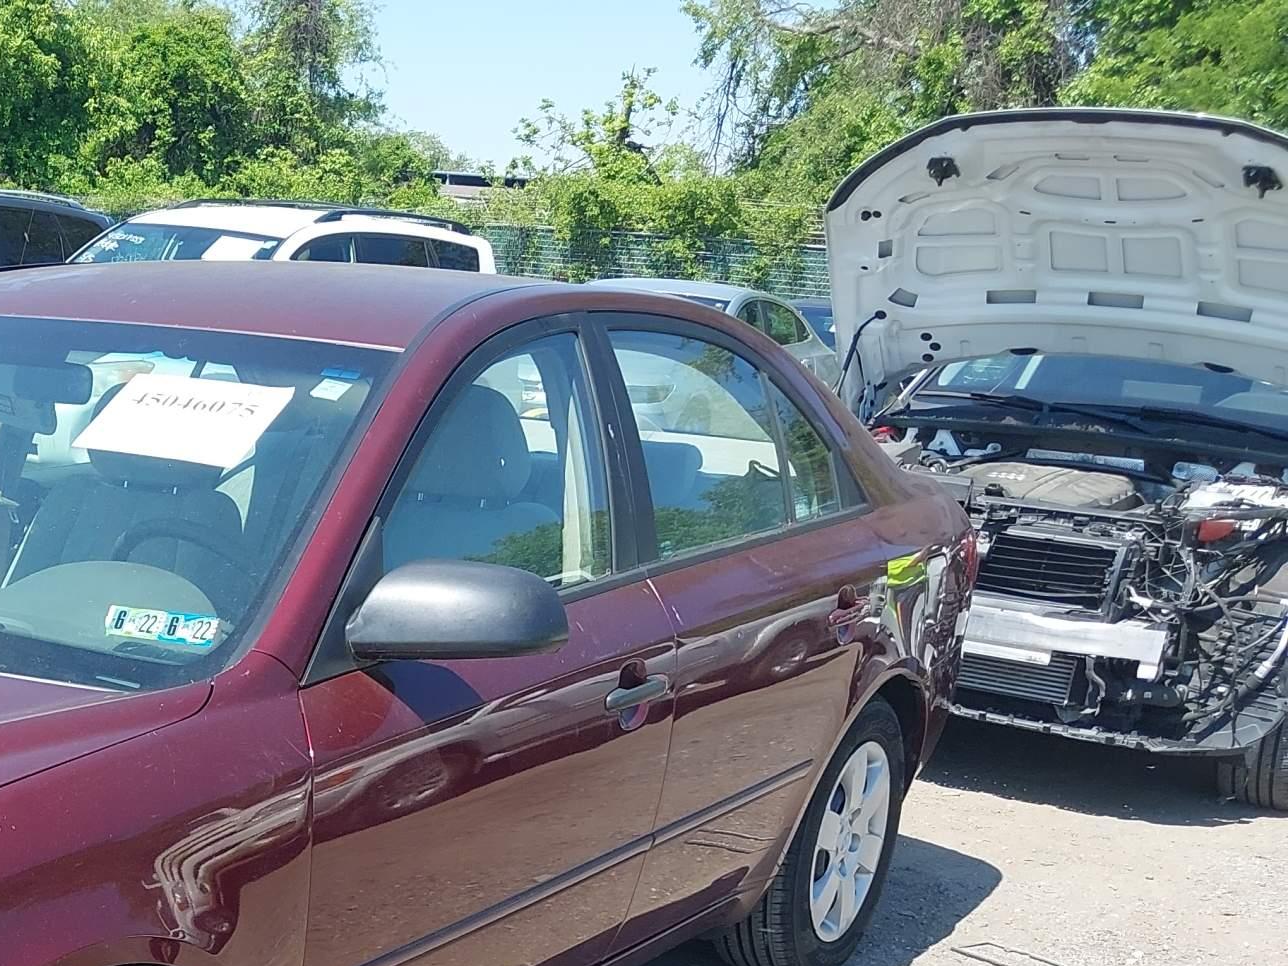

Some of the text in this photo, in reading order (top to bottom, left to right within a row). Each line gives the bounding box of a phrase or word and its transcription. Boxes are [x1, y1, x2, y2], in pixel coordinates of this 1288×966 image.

[132, 391, 260, 418] 45046075
[114, 610, 158, 634] 6 22
[167, 616, 212, 640] 6 22
